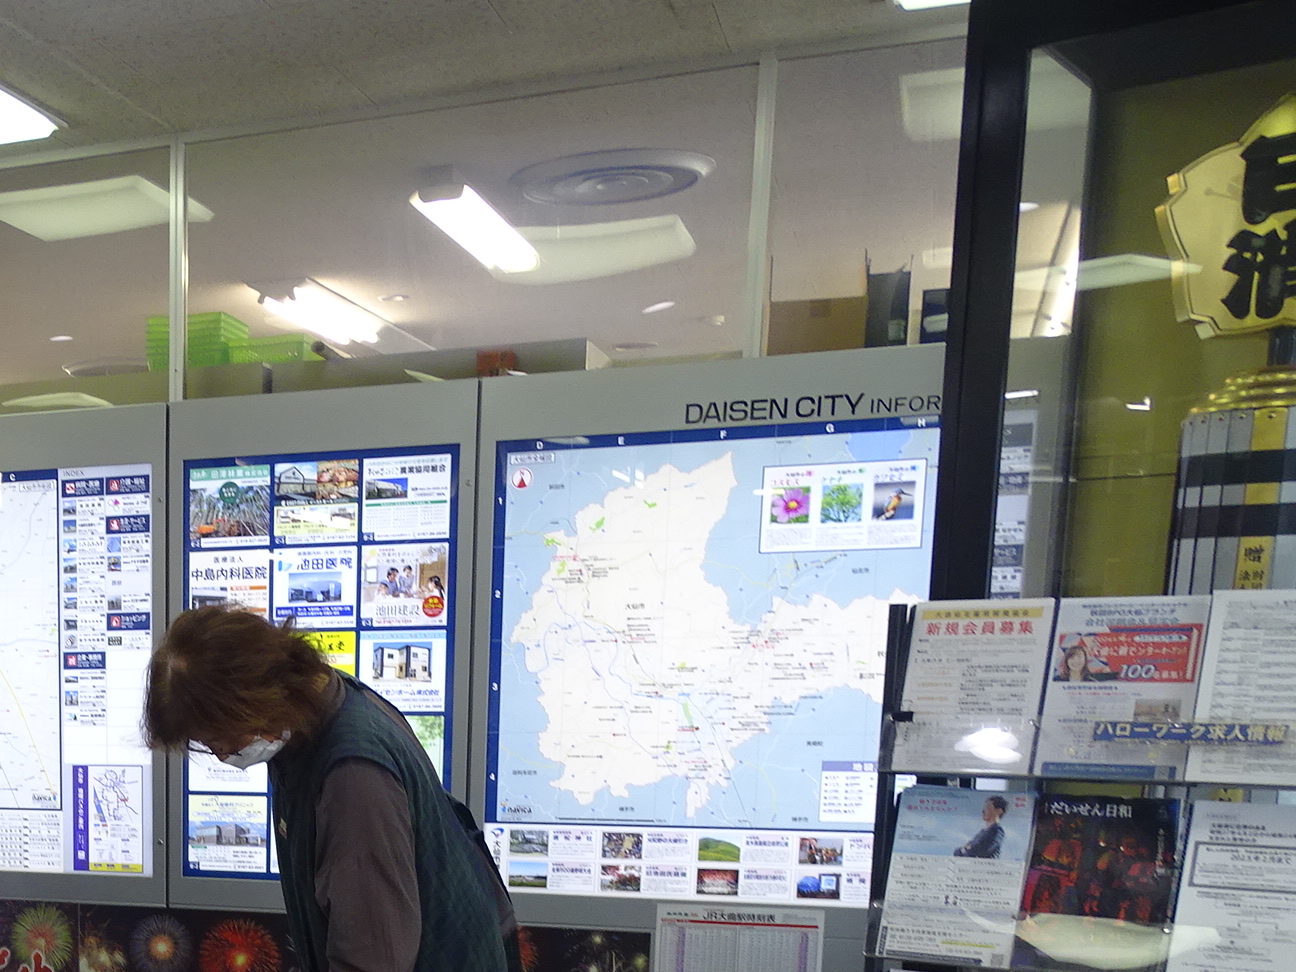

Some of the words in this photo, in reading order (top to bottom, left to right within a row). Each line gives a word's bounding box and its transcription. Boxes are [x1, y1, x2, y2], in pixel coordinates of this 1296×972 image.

[684, 397, 789, 425] DAISEN
[794, 392, 866, 420] CITY
[719, 430, 727, 440] F
[825, 423, 835, 434] G
[536, 441, 544, 450] D
[617, 436, 625, 446] E
[213, 555, 243, 564] 医療法人
[296, 556, 353, 571] 池田医院
[191, 566, 268, 582] 中島内科医院
[375, 604, 421, 617] 池田建設
[925, 620, 1035, 637] 新規会員募集
[1095, 722, 1287, 743] ハローワーク求人情報
[1050, 800, 1134, 819] だいせん日和
